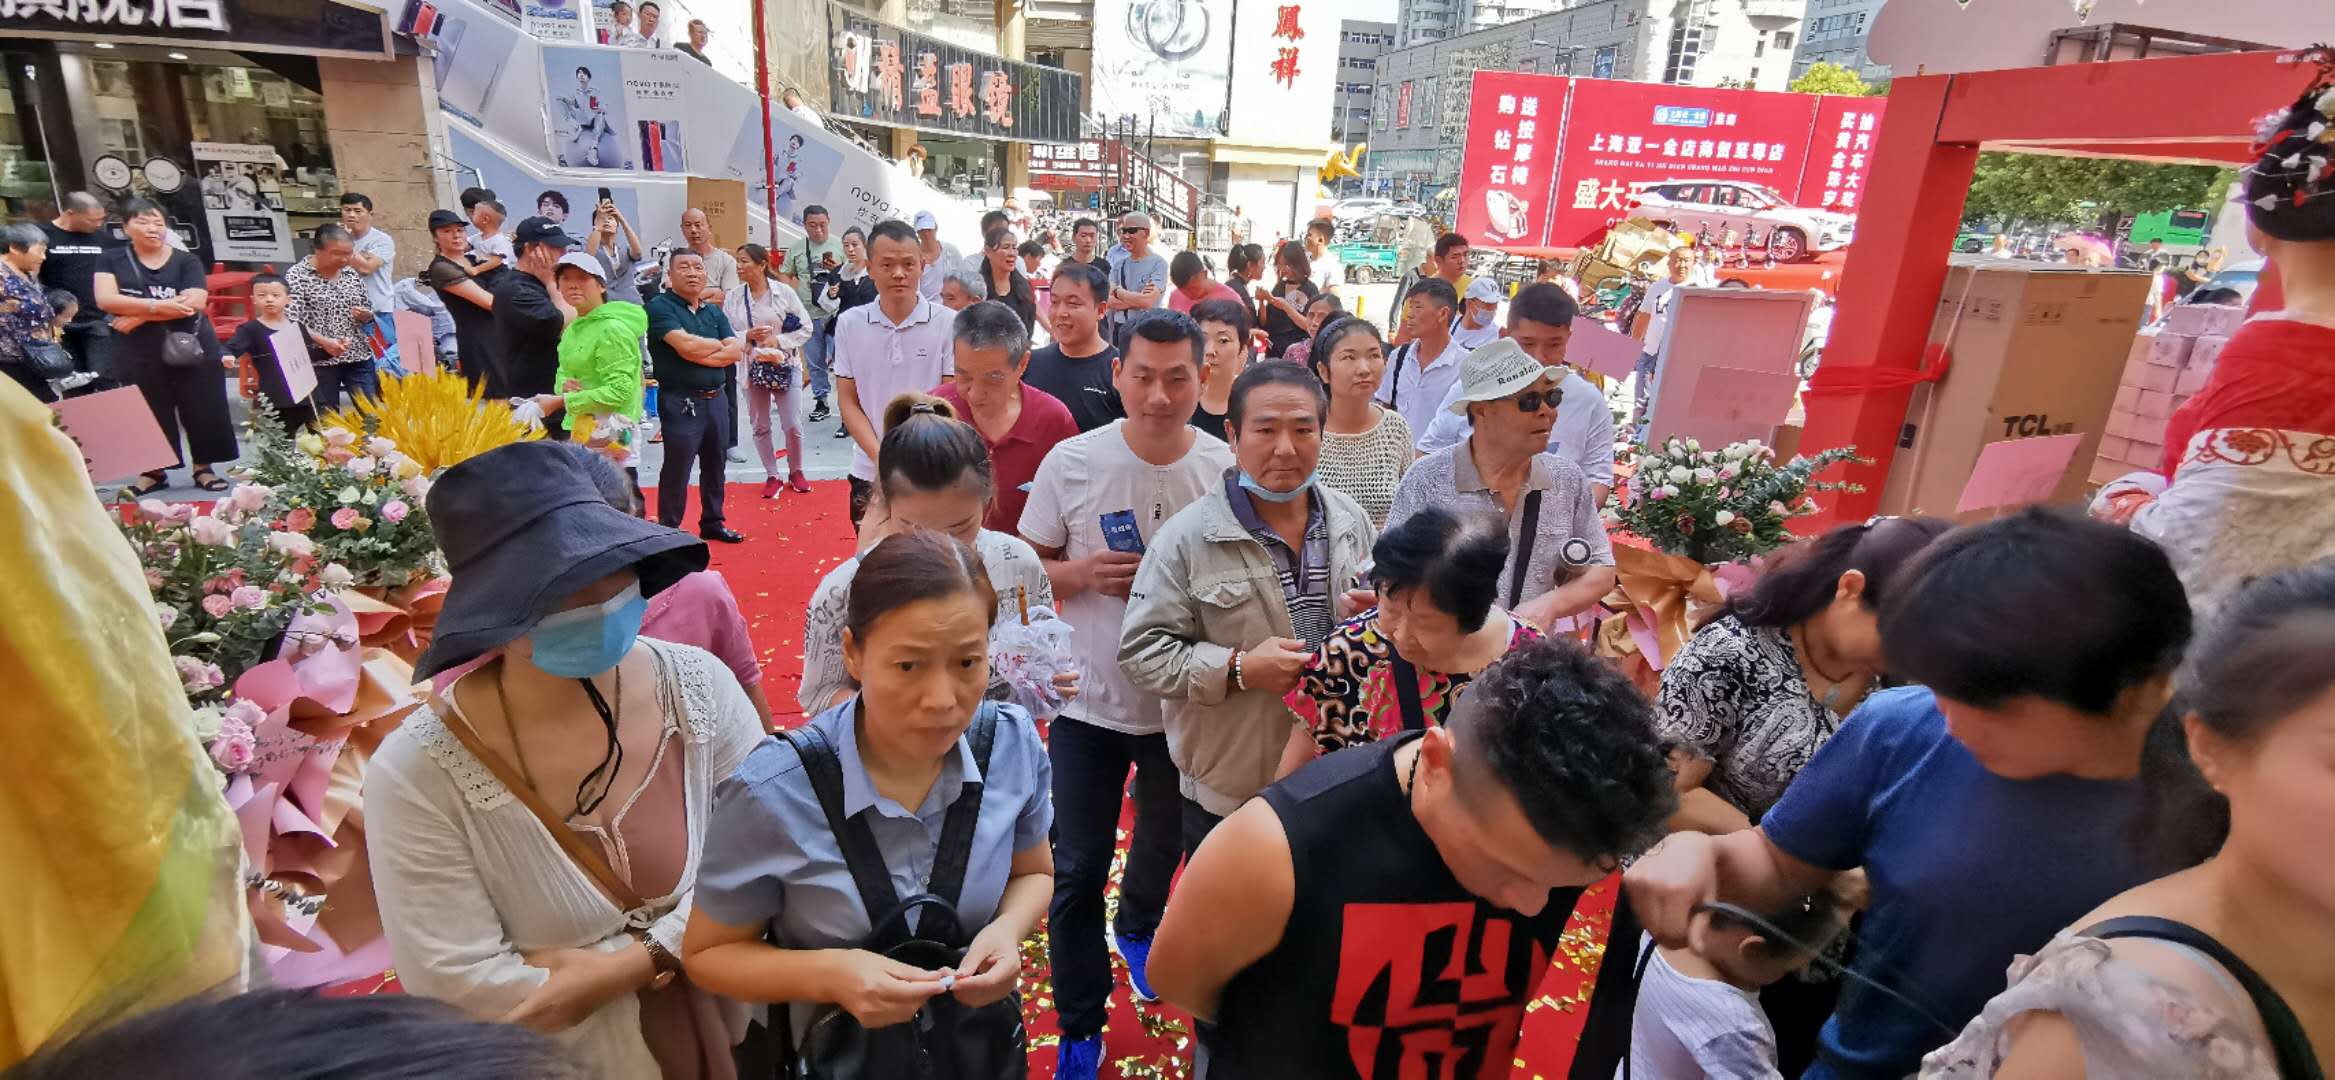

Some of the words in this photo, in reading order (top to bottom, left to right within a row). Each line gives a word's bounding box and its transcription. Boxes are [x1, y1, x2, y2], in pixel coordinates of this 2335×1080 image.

[1270, 4, 1304, 91] 鳳祥
[1490, 94, 1516, 184] 购钻石
[1511, 96, 1538, 185] 送按摩椅
[1588, 132, 1786, 161] 上海亚一金店商贸至尊店
[851, 186, 889, 211] nova
[2003, 414, 2051, 437] TCL
